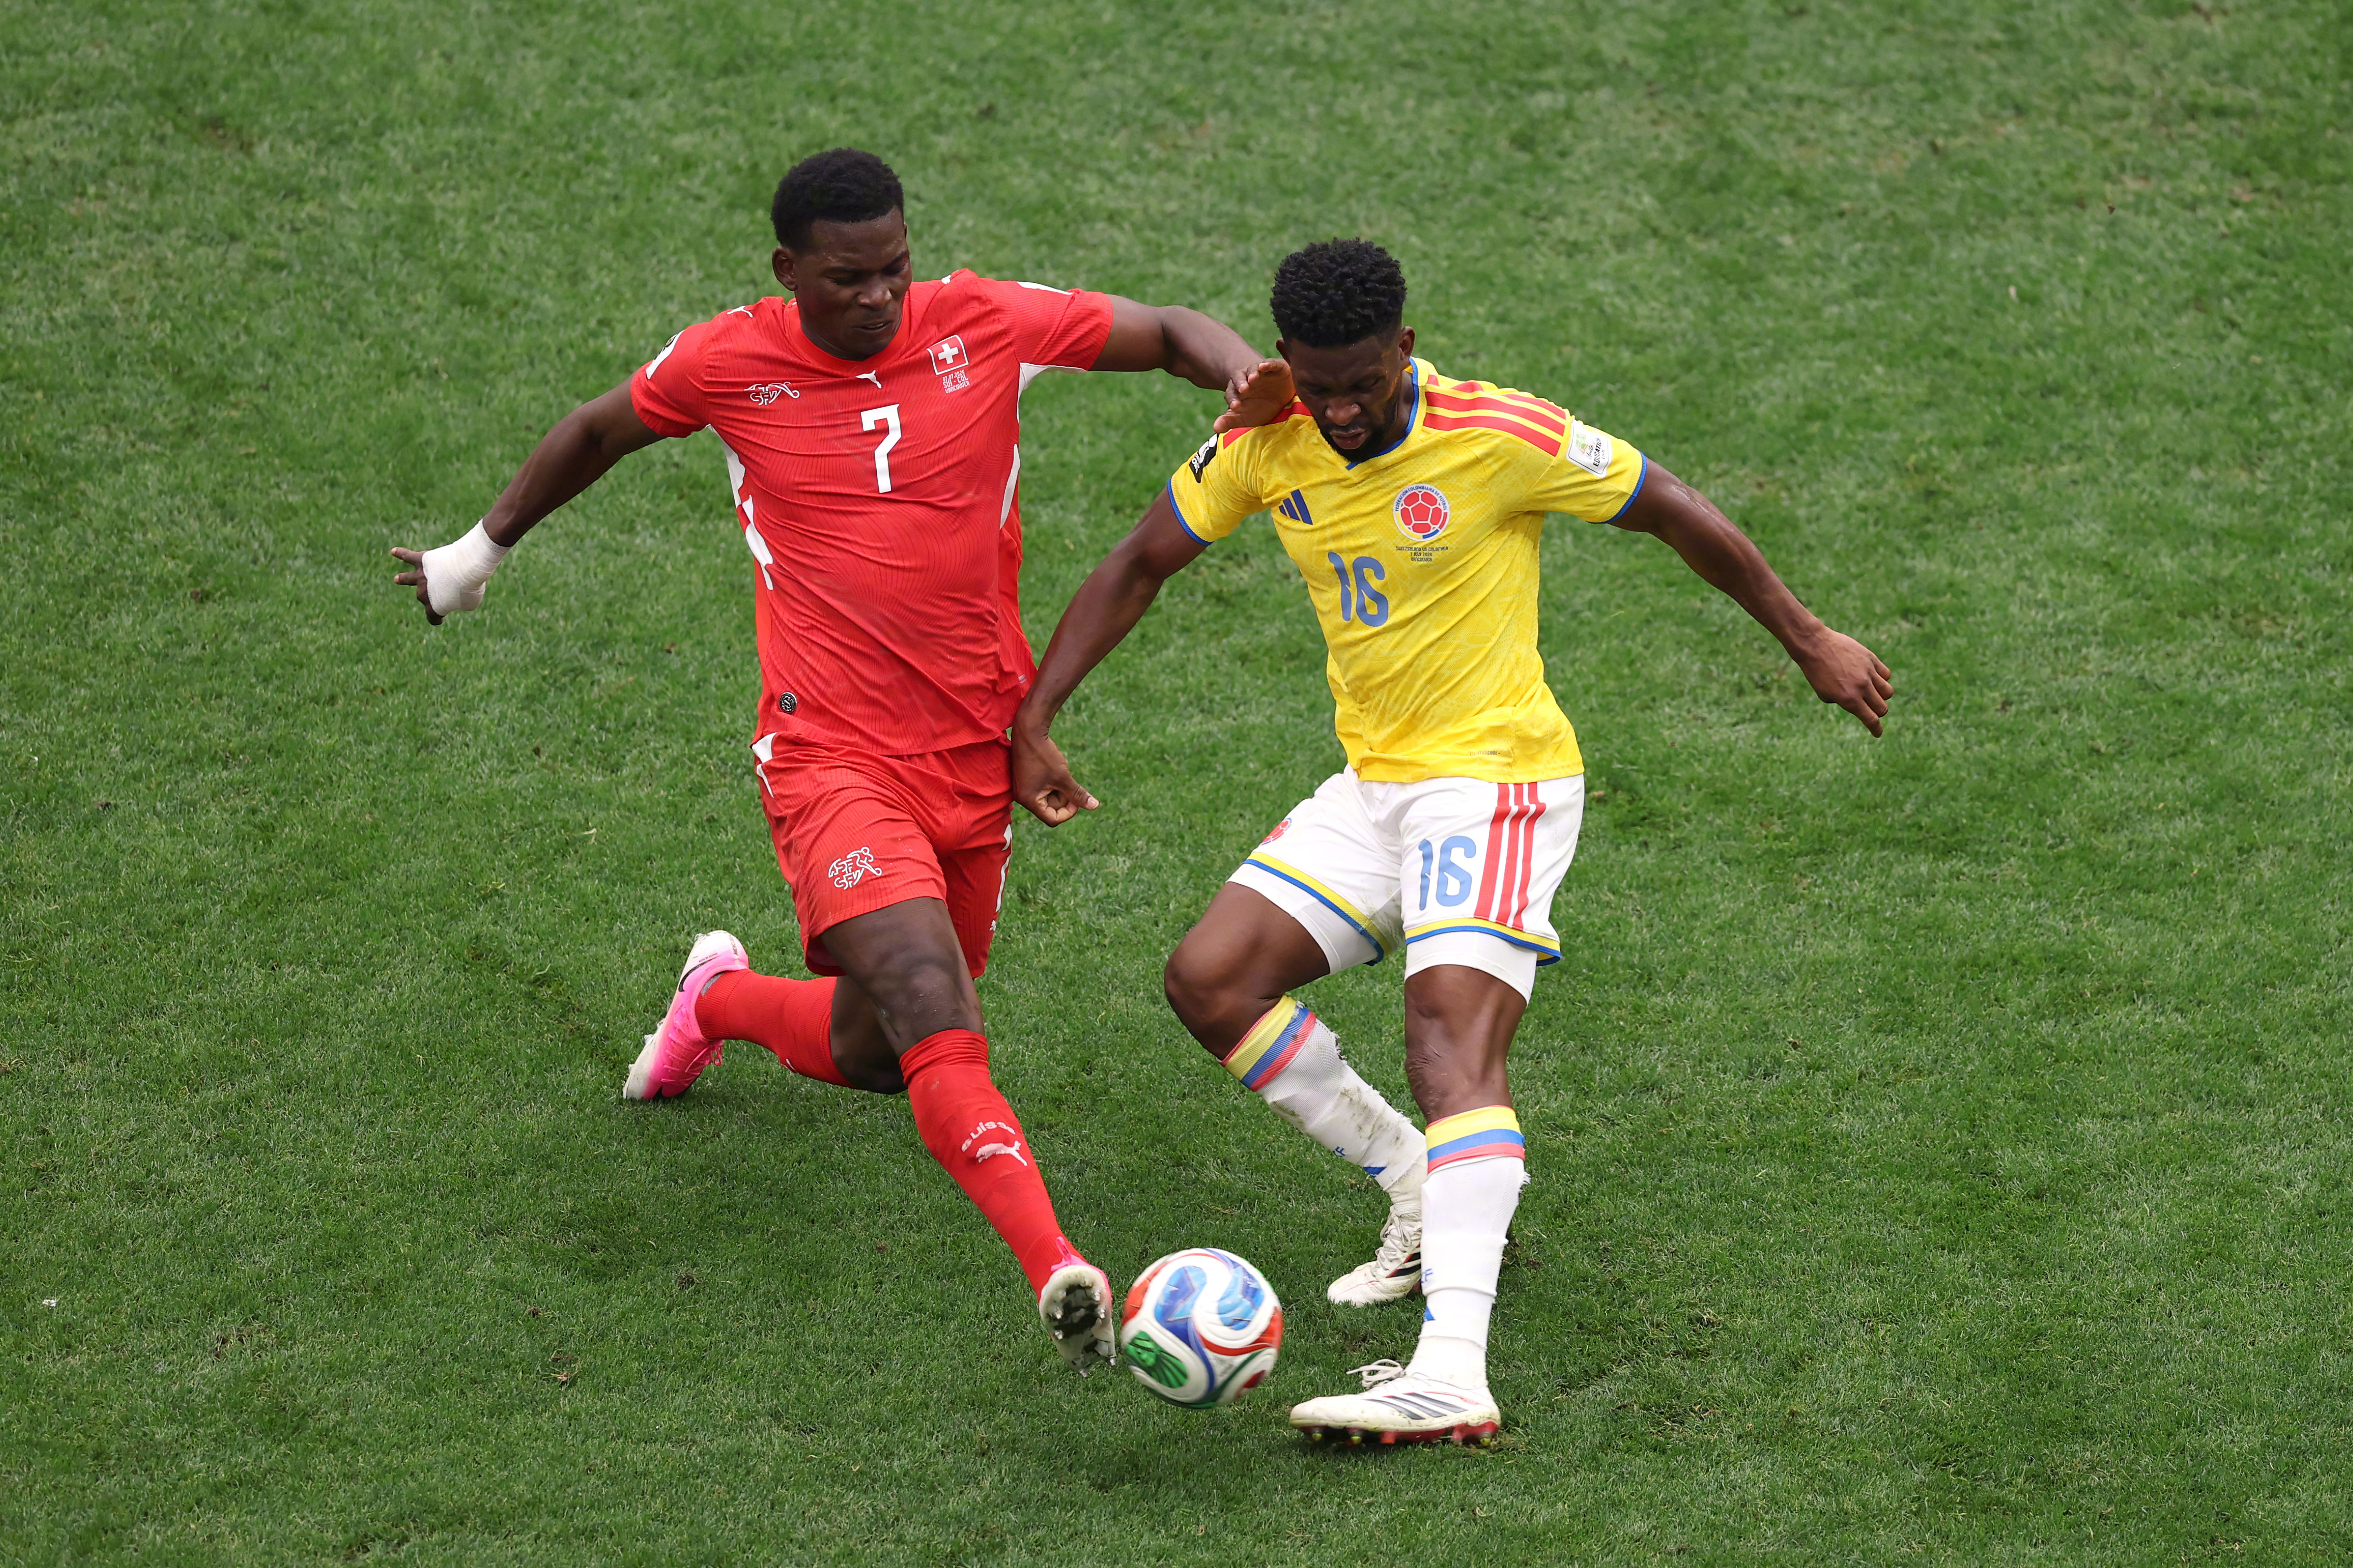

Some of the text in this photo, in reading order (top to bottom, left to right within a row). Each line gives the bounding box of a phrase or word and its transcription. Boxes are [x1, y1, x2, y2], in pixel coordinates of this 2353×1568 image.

[943, 380, 953, 389] SUI
[945, 381, 971, 394] VANCOUVER
[861, 404, 901, 493] 7
[1593, 437, 1602, 467] EDUCATION
[1395, 489, 1408, 512] FEDERACIÓN
[1328, 551, 1389, 627] 16
[1418, 835, 1476, 911] 16
